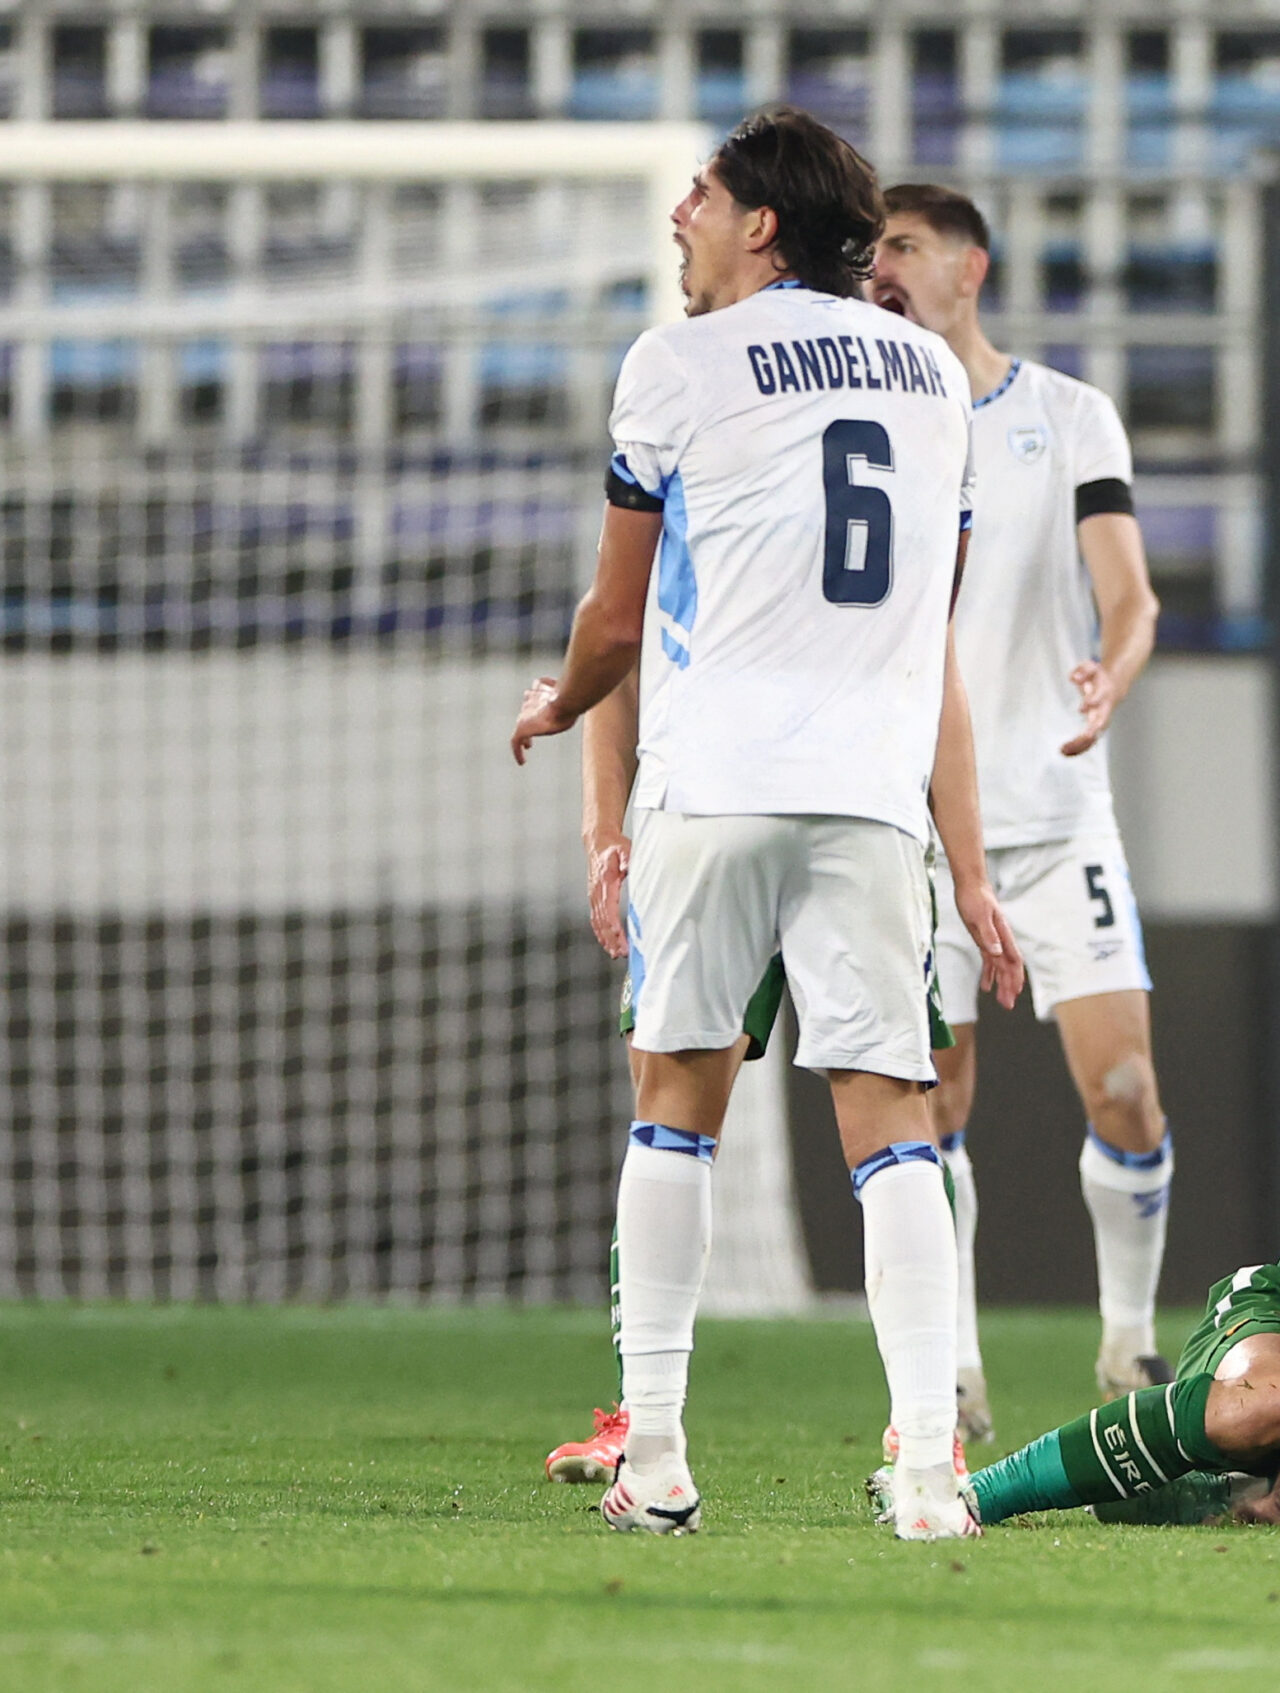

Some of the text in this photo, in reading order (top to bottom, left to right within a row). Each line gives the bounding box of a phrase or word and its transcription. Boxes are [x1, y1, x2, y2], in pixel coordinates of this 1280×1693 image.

[747, 335, 947, 398] GANDELMAN
[822, 419, 895, 607] 6
[1084, 865, 1115, 928] 5
